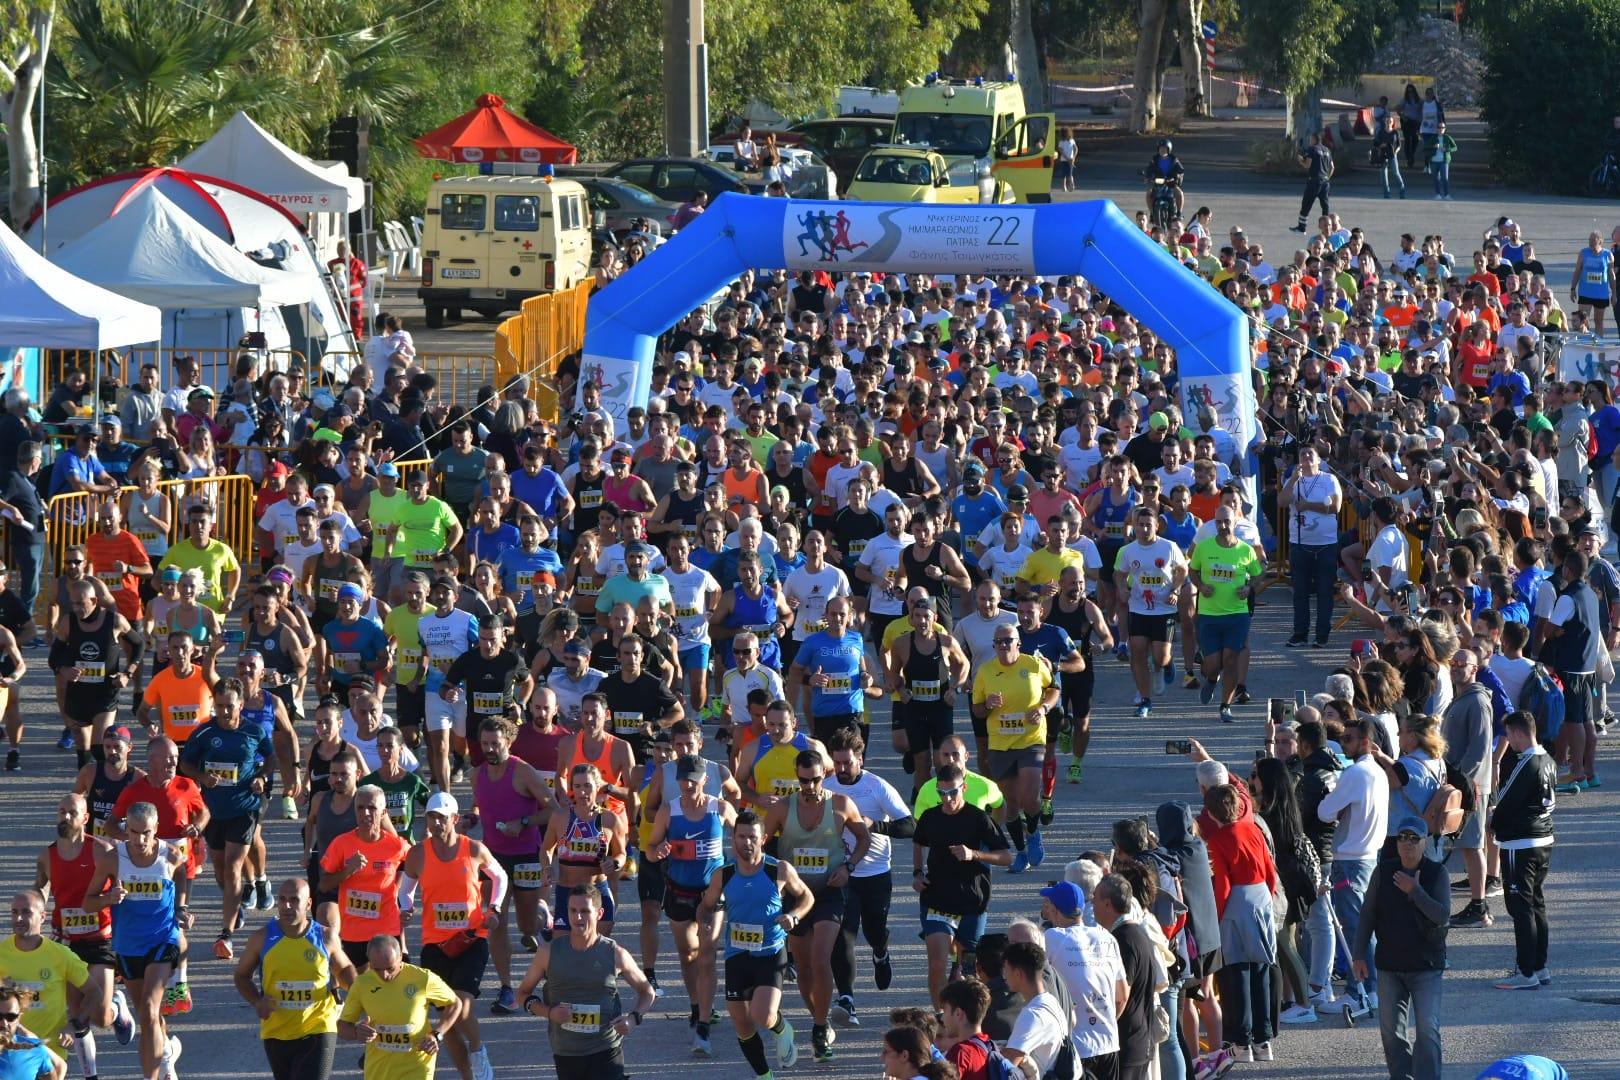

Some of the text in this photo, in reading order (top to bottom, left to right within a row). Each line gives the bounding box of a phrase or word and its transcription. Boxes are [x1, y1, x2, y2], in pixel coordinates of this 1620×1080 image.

[946, 237, 980, 247] ΠΑΤΡΑΣ
[1000, 719, 1024, 728] 1554
[797, 855, 825, 866] 1015
[129, 882, 159, 894] 1070
[349, 897, 377, 910] 1336
[438, 910, 465, 922] 1649
[733, 930, 760, 943] 1652
[281, 988, 312, 1002] 1215
[572, 1013, 595, 1025] 571
[377, 1032, 410, 1045] 1045
